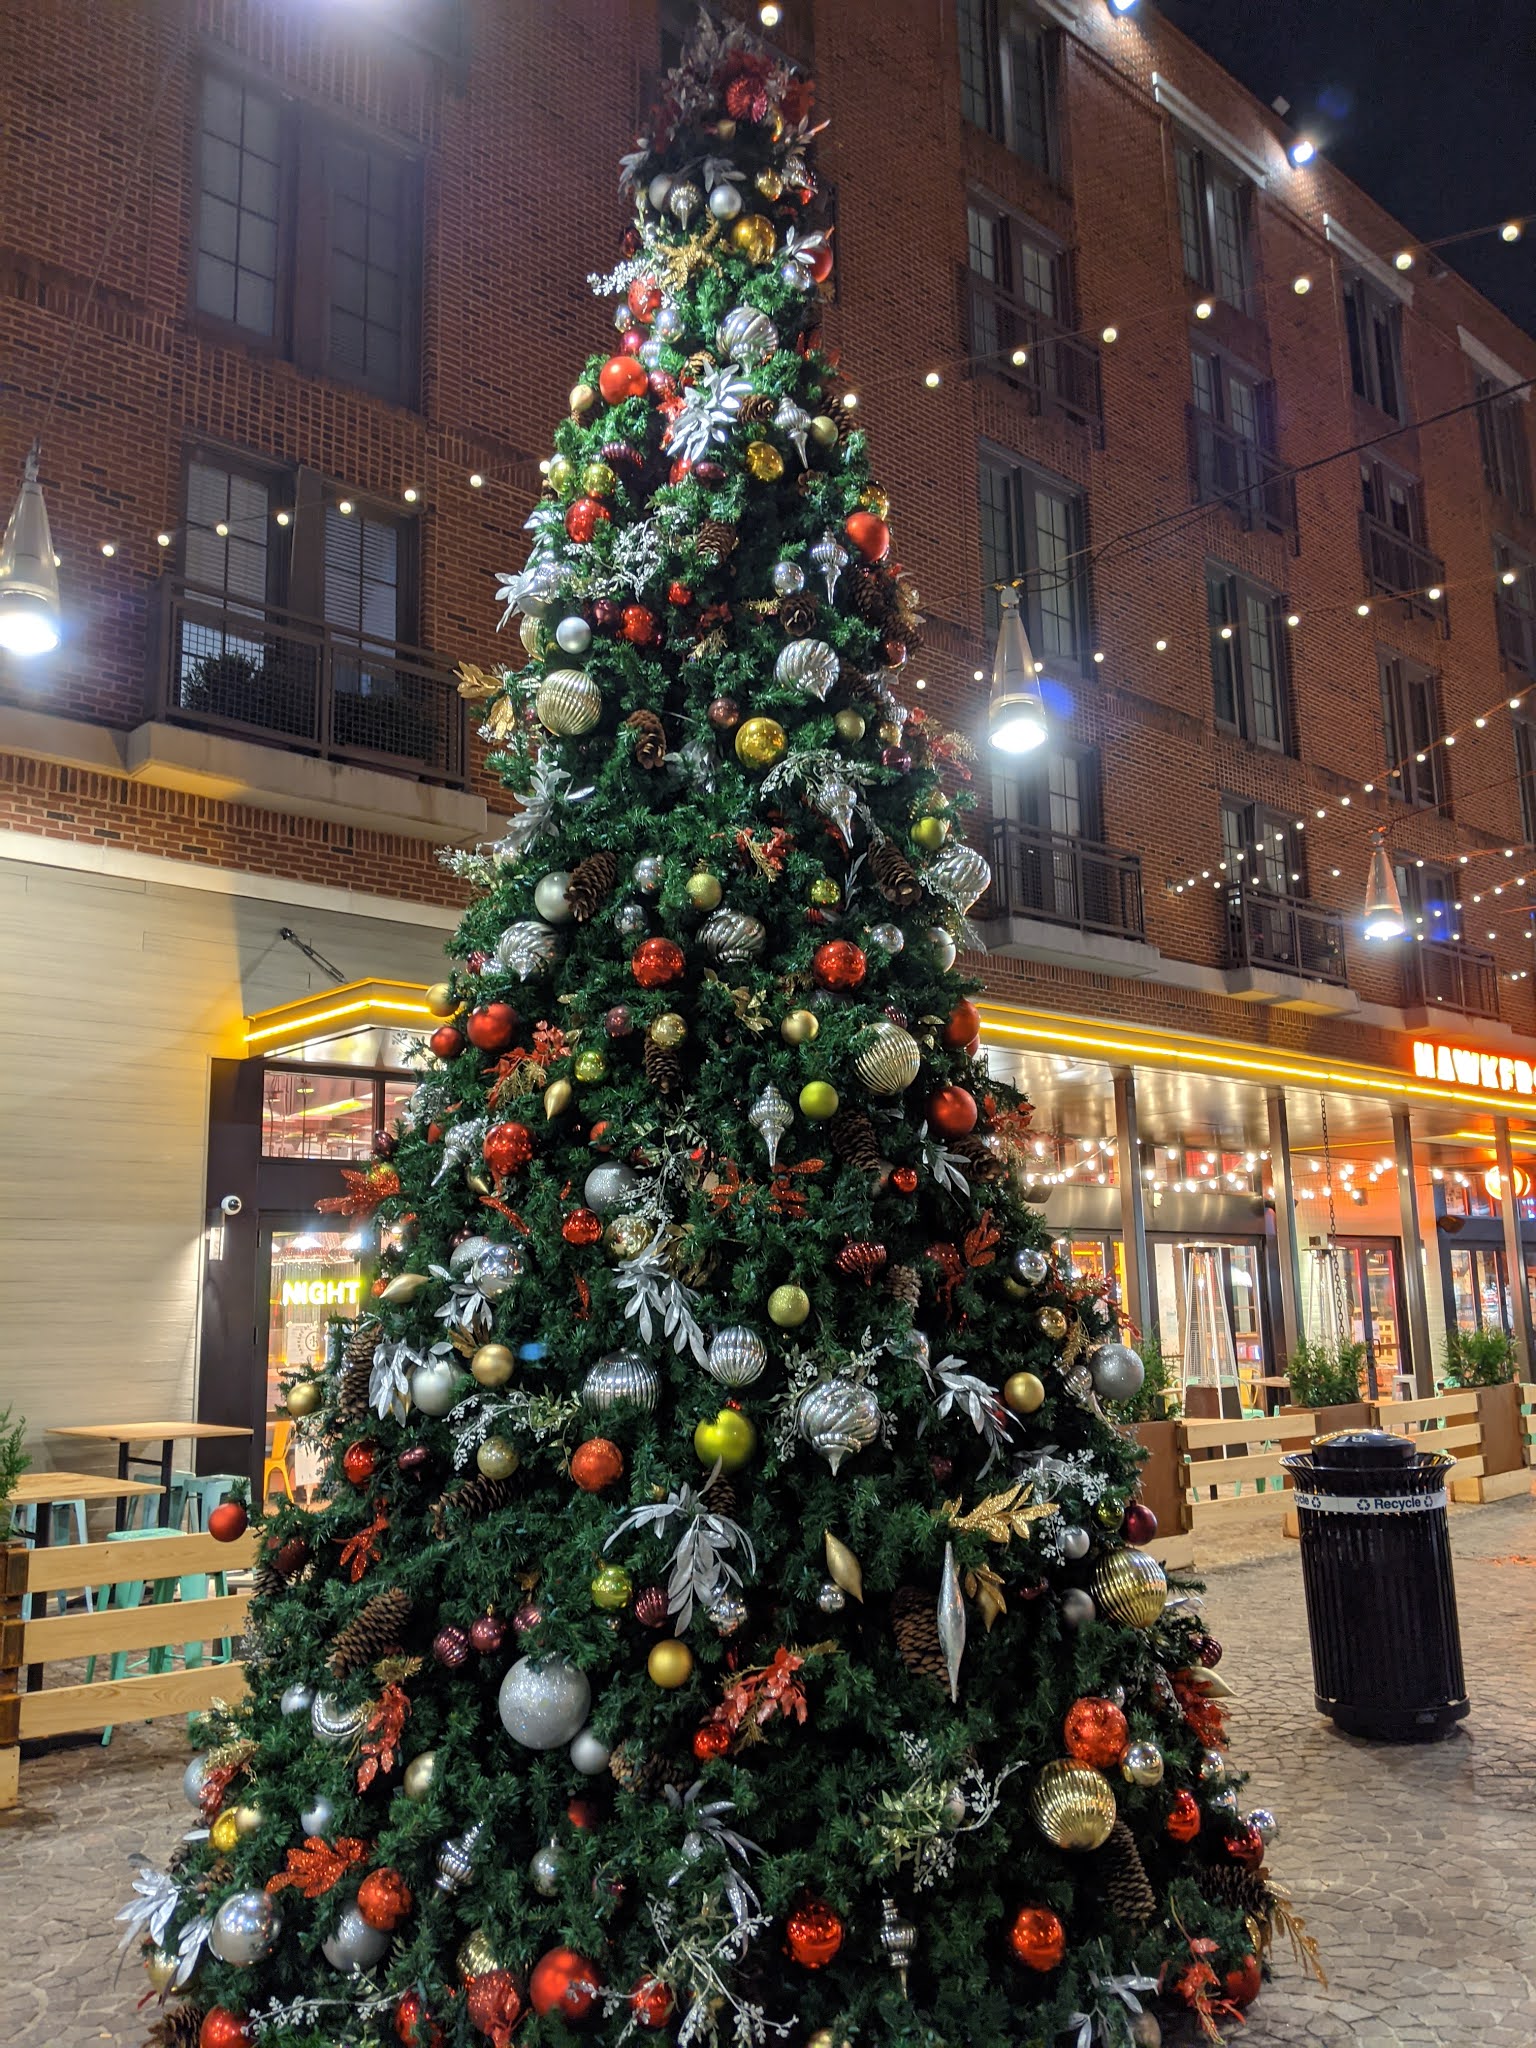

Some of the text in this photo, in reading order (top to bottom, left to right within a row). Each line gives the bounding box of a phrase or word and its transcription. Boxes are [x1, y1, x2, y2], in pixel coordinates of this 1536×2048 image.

[1413, 1041, 1536, 1095] HAWKER
[282, 1280, 360, 1306] NIGHT
[1374, 1497, 1422, 1511] Recycle
